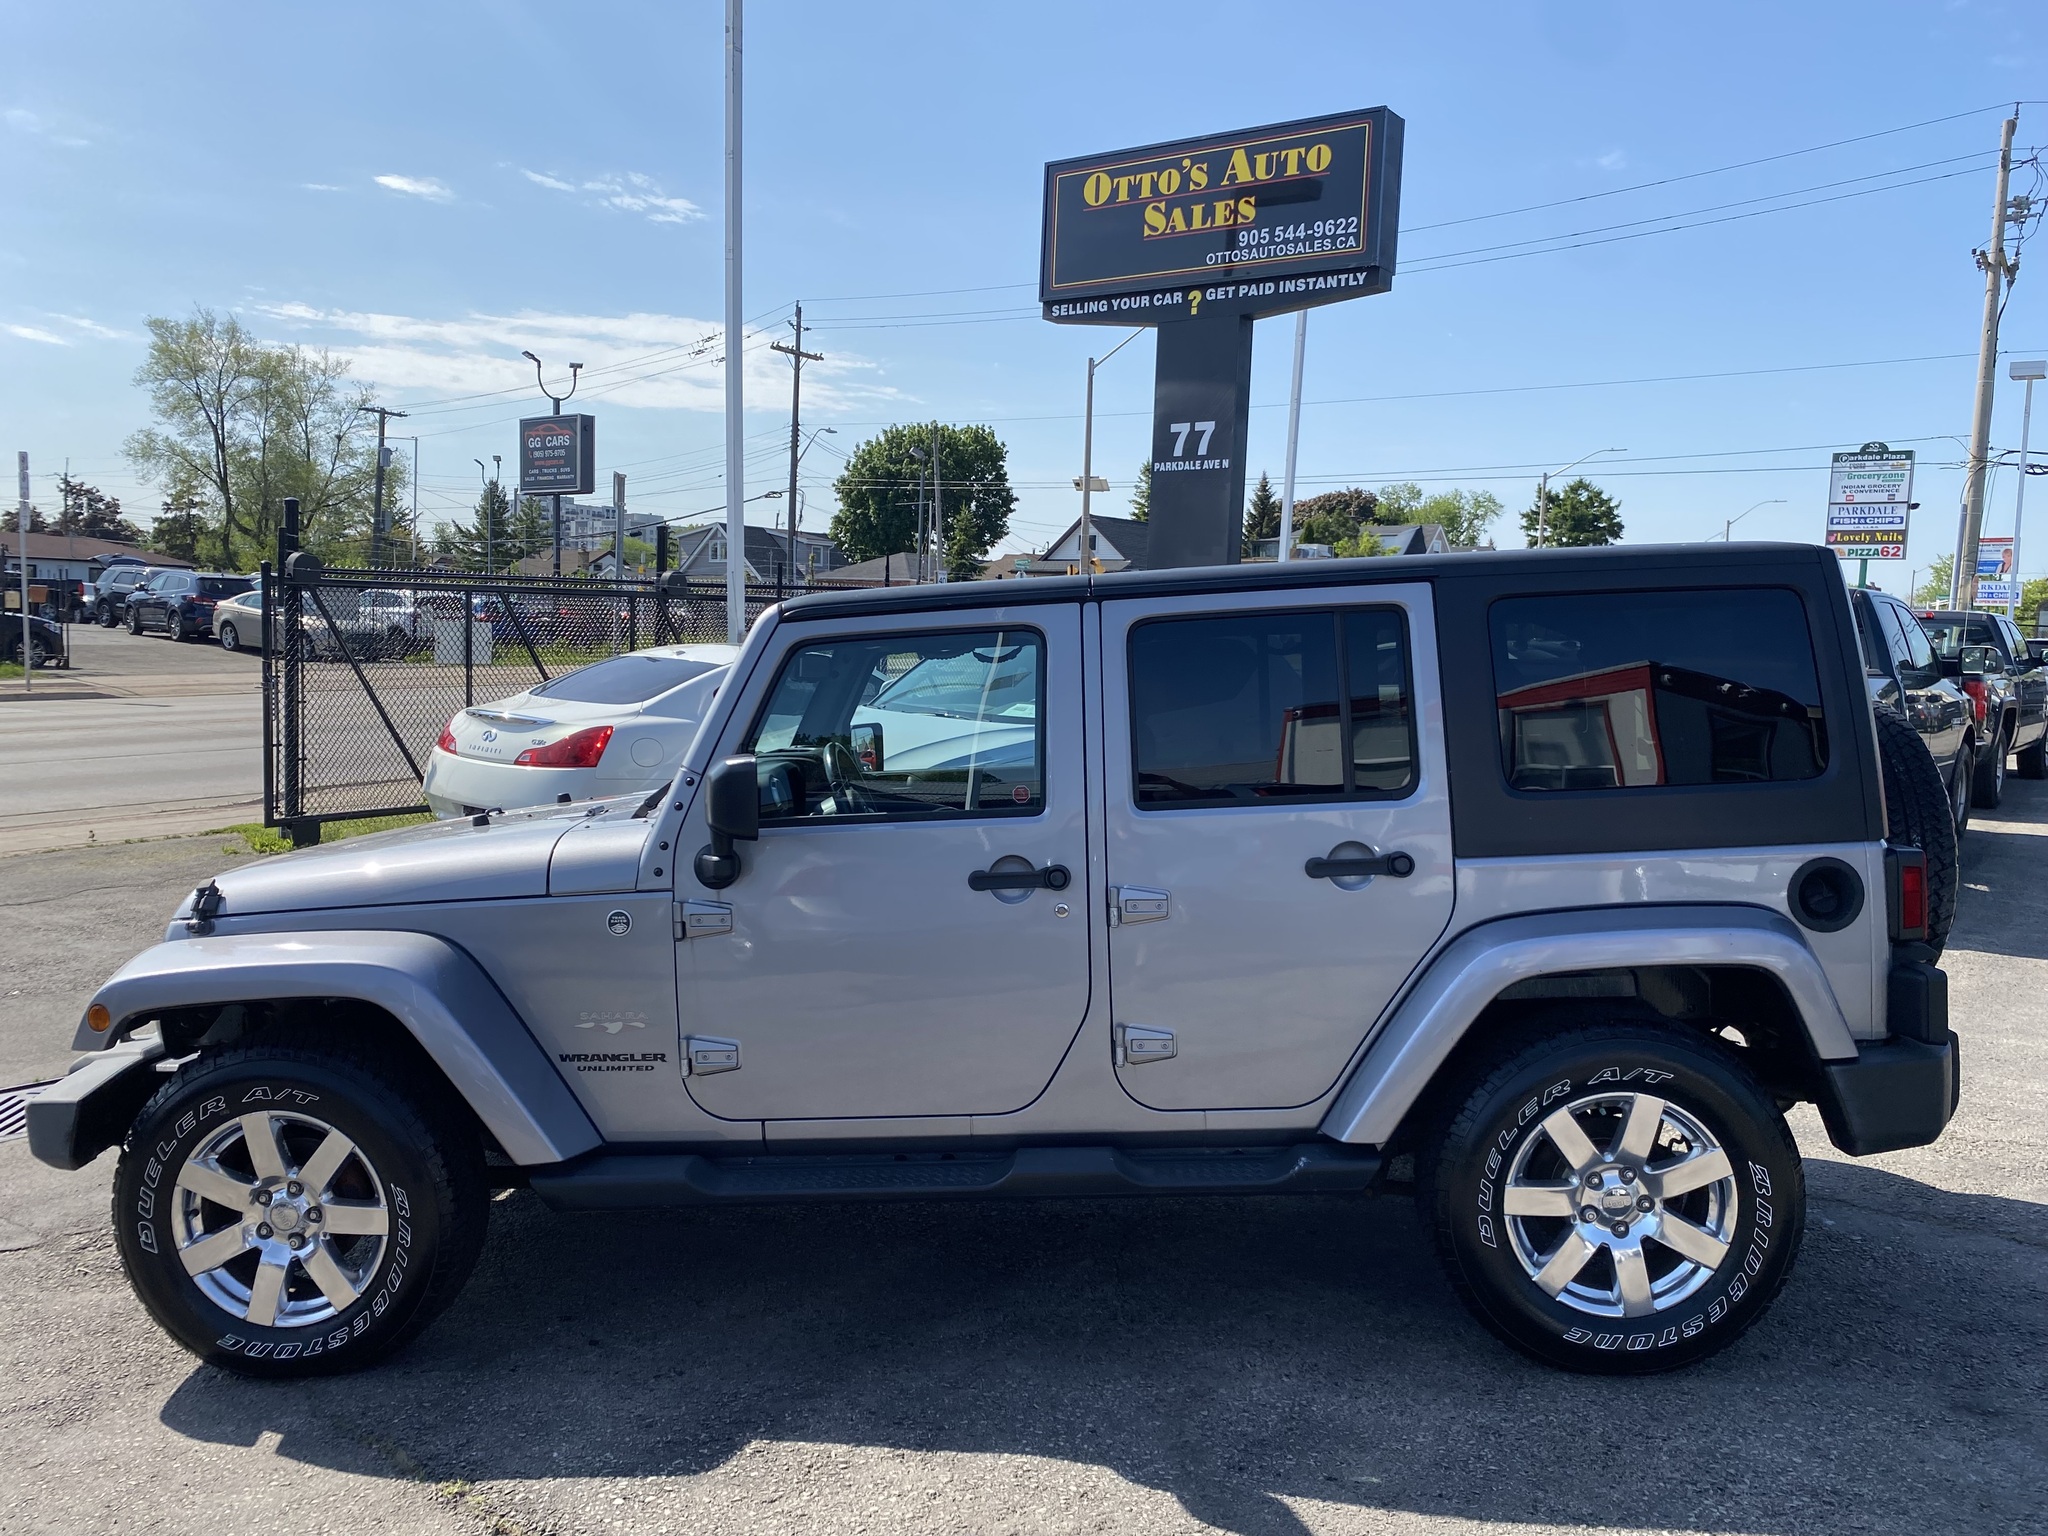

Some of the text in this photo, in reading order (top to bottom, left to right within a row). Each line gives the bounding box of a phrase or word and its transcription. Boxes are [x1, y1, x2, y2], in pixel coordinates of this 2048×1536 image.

[1083, 144, 1332, 207] OTTO'S AUTO
[1144, 197, 1256, 237] SALES
[1238, 216, 1358, 247] 905 544-9622
[1206, 236, 1356, 265] OTTOSAUTOSALES.CA
[1051, 300, 1108, 317] SELLING
[1111, 295, 1150, 311] YOUR
[1153, 292, 1183, 306] CAR
[1205, 286, 1236, 301] GET
[1238, 282, 1275, 298] PAID
[1279, 272, 1367, 293] INSTANTLY
[528, 435, 570, 448] GG CARS
[1170, 421, 1216, 457] 77
[1154, 459, 1229, 472] PARKDALE AVE N
[1847, 472, 1905, 481] Groceryzone
[1838, 505, 1898, 516] PARKDALE
[1836, 531, 1903, 544] Lovely Nails
[580, 1011, 648, 1020] SAHARA
[559, 1053, 667, 1063] WRANGLER
[137, 1086, 320, 1254] DUELER A/T
[1476, 1067, 1674, 1248] DUELER A/T
[1563, 1160, 1773, 1350] BRIDGESTONE
[216, 1183, 411, 1359] BRIDGESTONE
